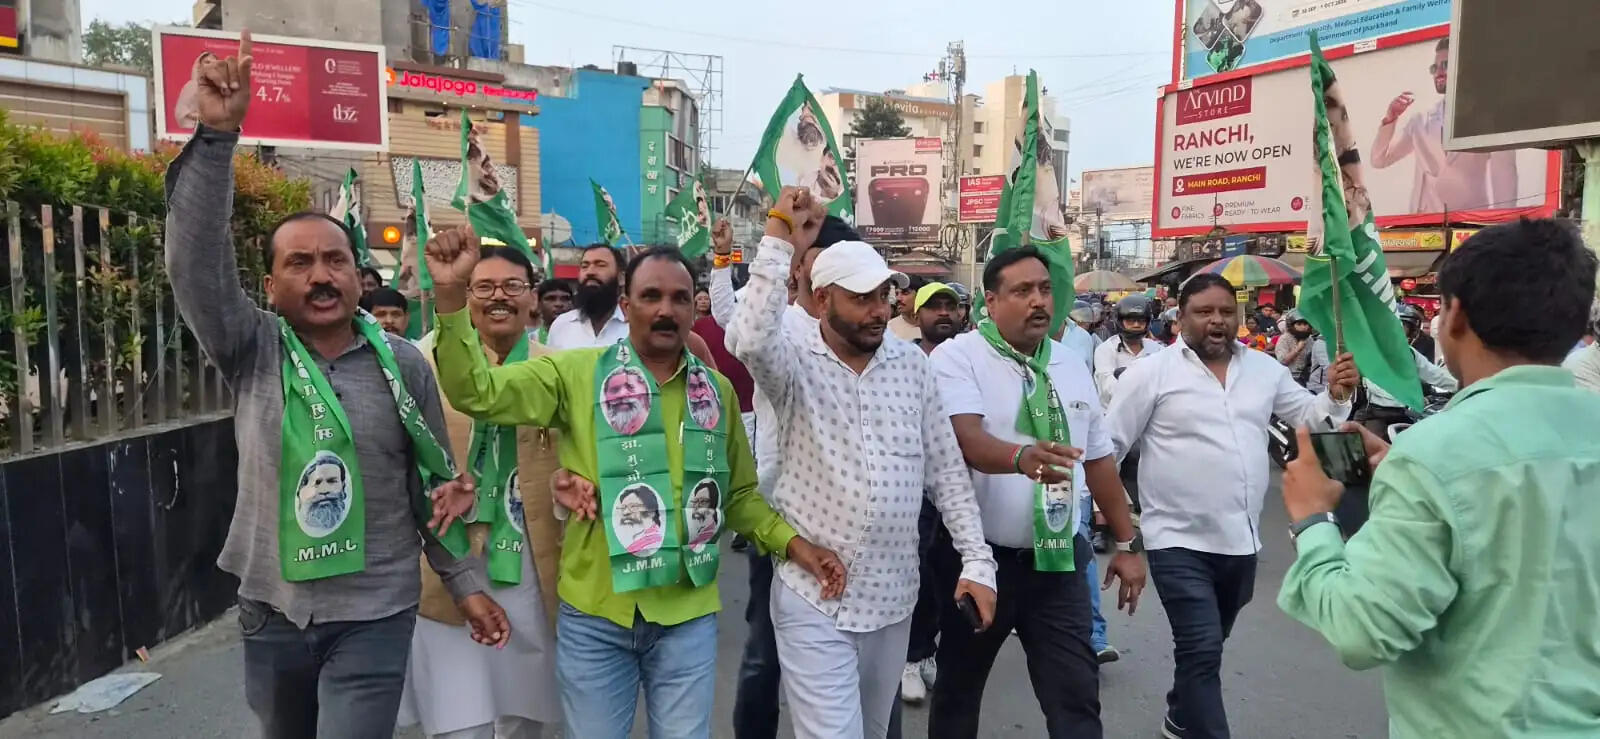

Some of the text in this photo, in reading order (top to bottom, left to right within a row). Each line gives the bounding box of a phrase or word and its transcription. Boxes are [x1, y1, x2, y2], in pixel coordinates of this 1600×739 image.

[1270, 31, 1303, 43] Department
[1334, 16, 1359, 28] Medical
[1360, 10, 1393, 22] Education
[1402, 3, 1425, 13] Family
[1318, 29, 1352, 41] overnment
[1362, 19, 1398, 32] Jharkhand
[400, 71, 477, 96] Jalajoga
[1197, 106, 1228, 119] STORE
[1174, 123, 1254, 151] RANCHI,
[1174, 144, 1292, 170] WE'RE NOW OPEN
[871, 164, 928, 177] PRO
[968, 178, 982, 186] IAS
[1188, 180, 1206, 188] MAIN
[1231, 173, 1261, 184] RANCHI
[966, 198, 984, 206] JPSC
[1224, 200, 1254, 208] PREMIUM
[622, 557, 666, 573] J.M.M.
